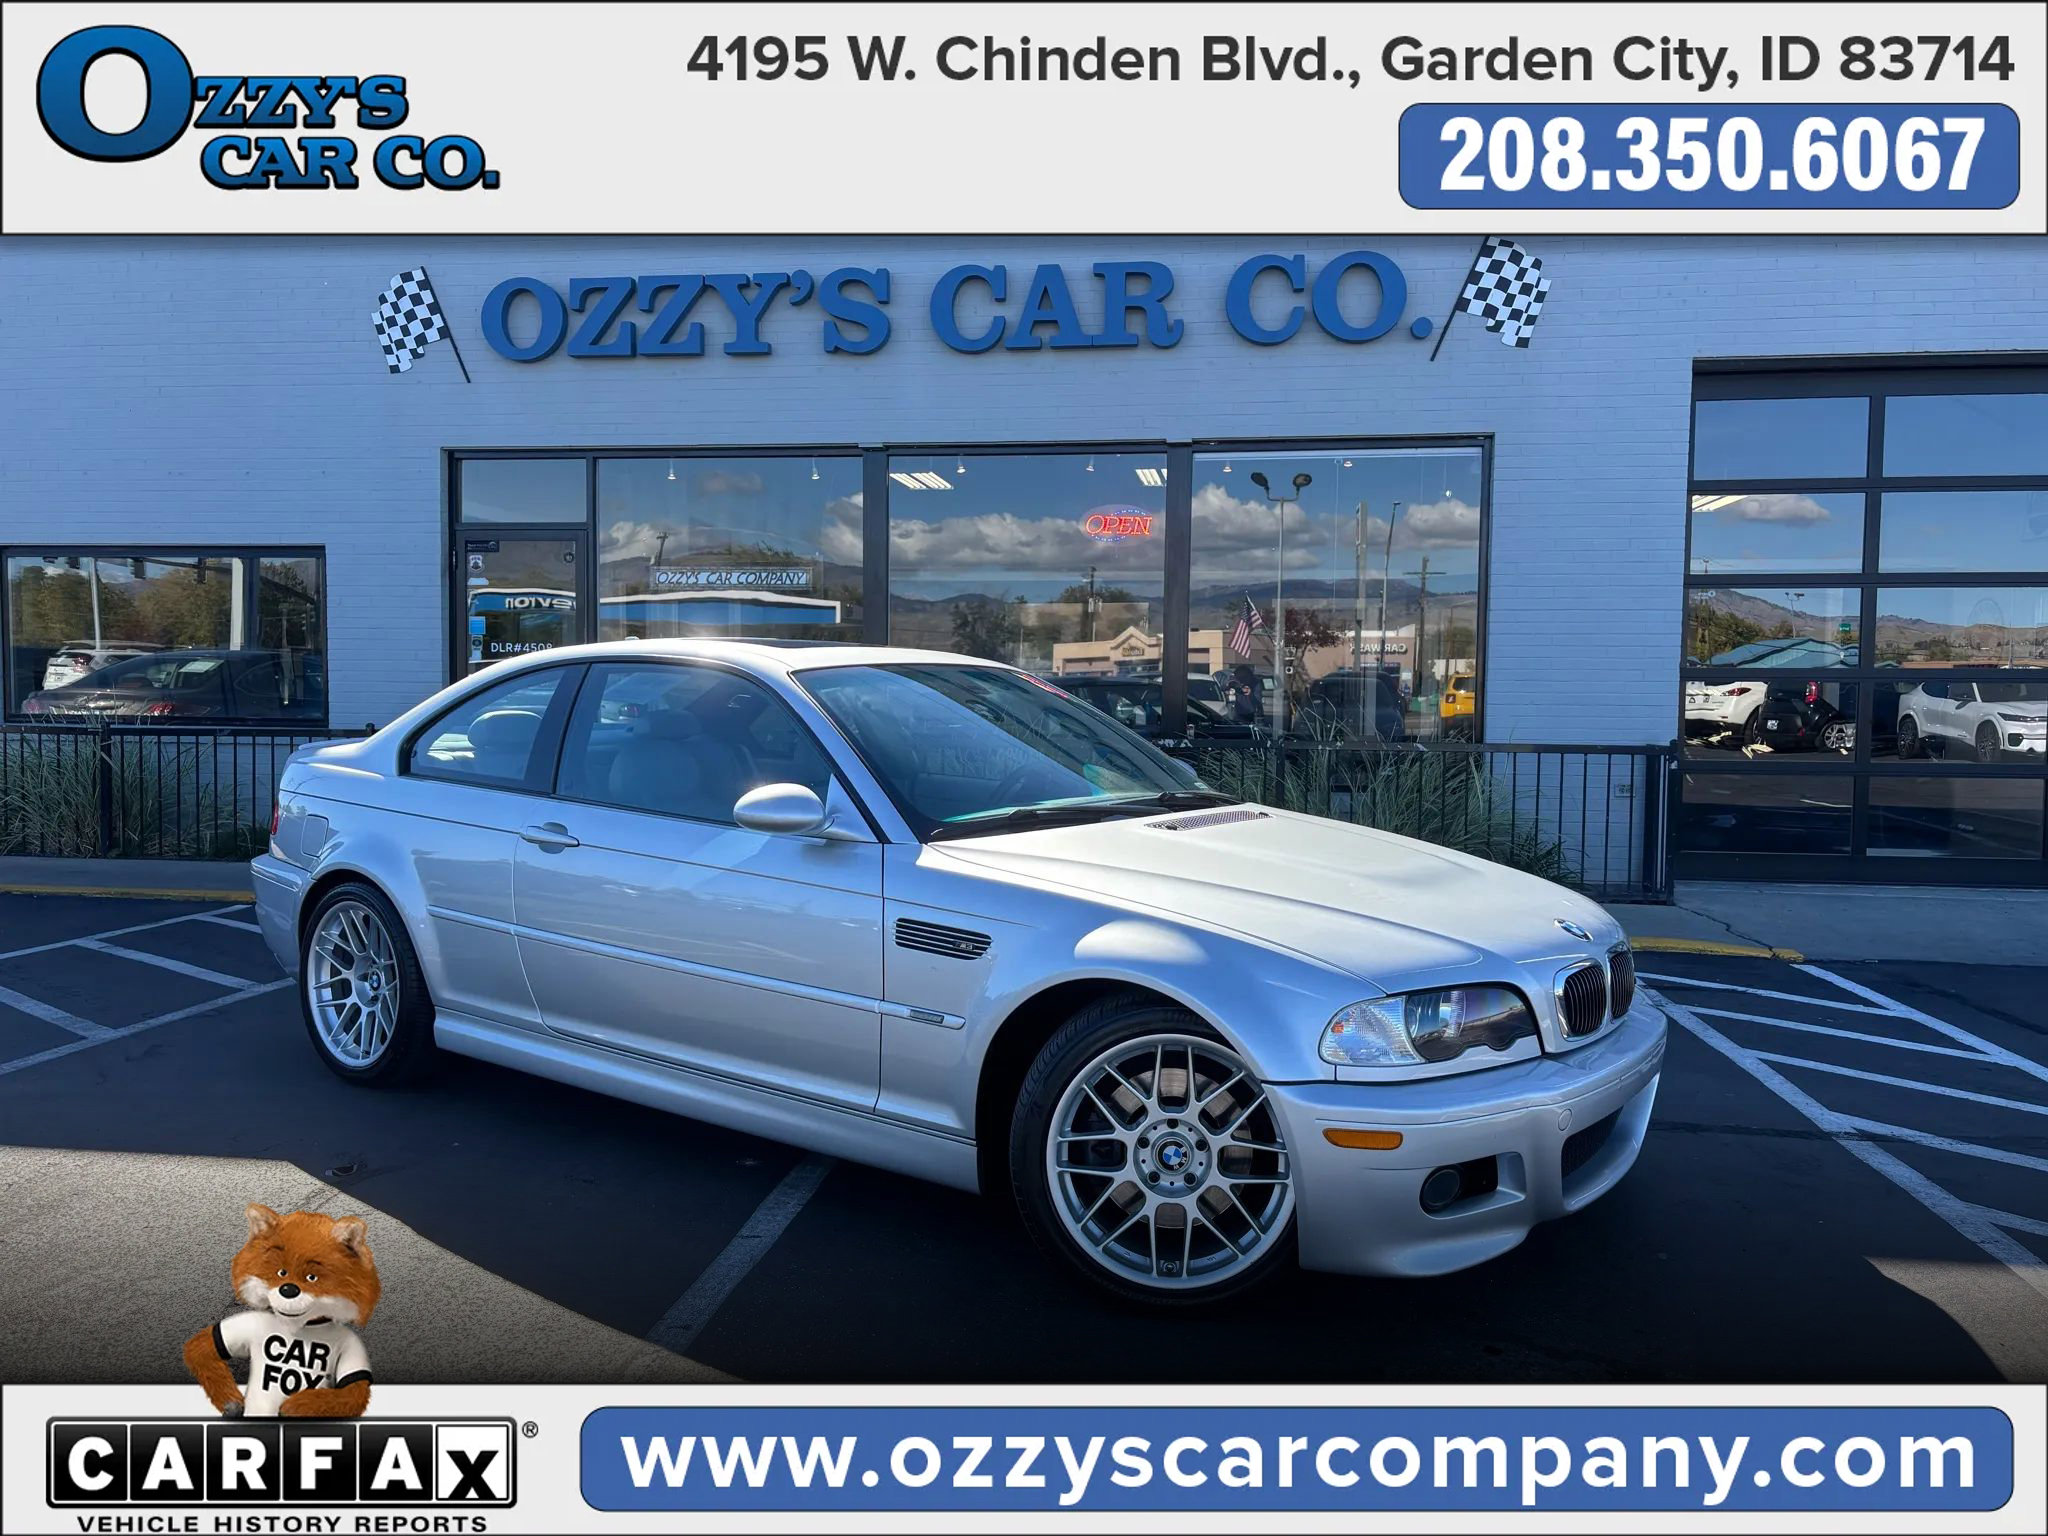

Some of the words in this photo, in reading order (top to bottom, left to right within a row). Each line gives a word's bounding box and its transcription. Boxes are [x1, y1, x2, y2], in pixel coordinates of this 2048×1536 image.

[481, 267, 891, 363] OZZY'S
[930, 261, 1184, 354] CAR
[1226, 251, 1433, 346] CO.
[1086, 515, 1152, 534] OPEN
[657, 571, 699, 585] OZZY'S
[706, 571, 732, 585] CAR
[736, 571, 804, 585] COMPANY
